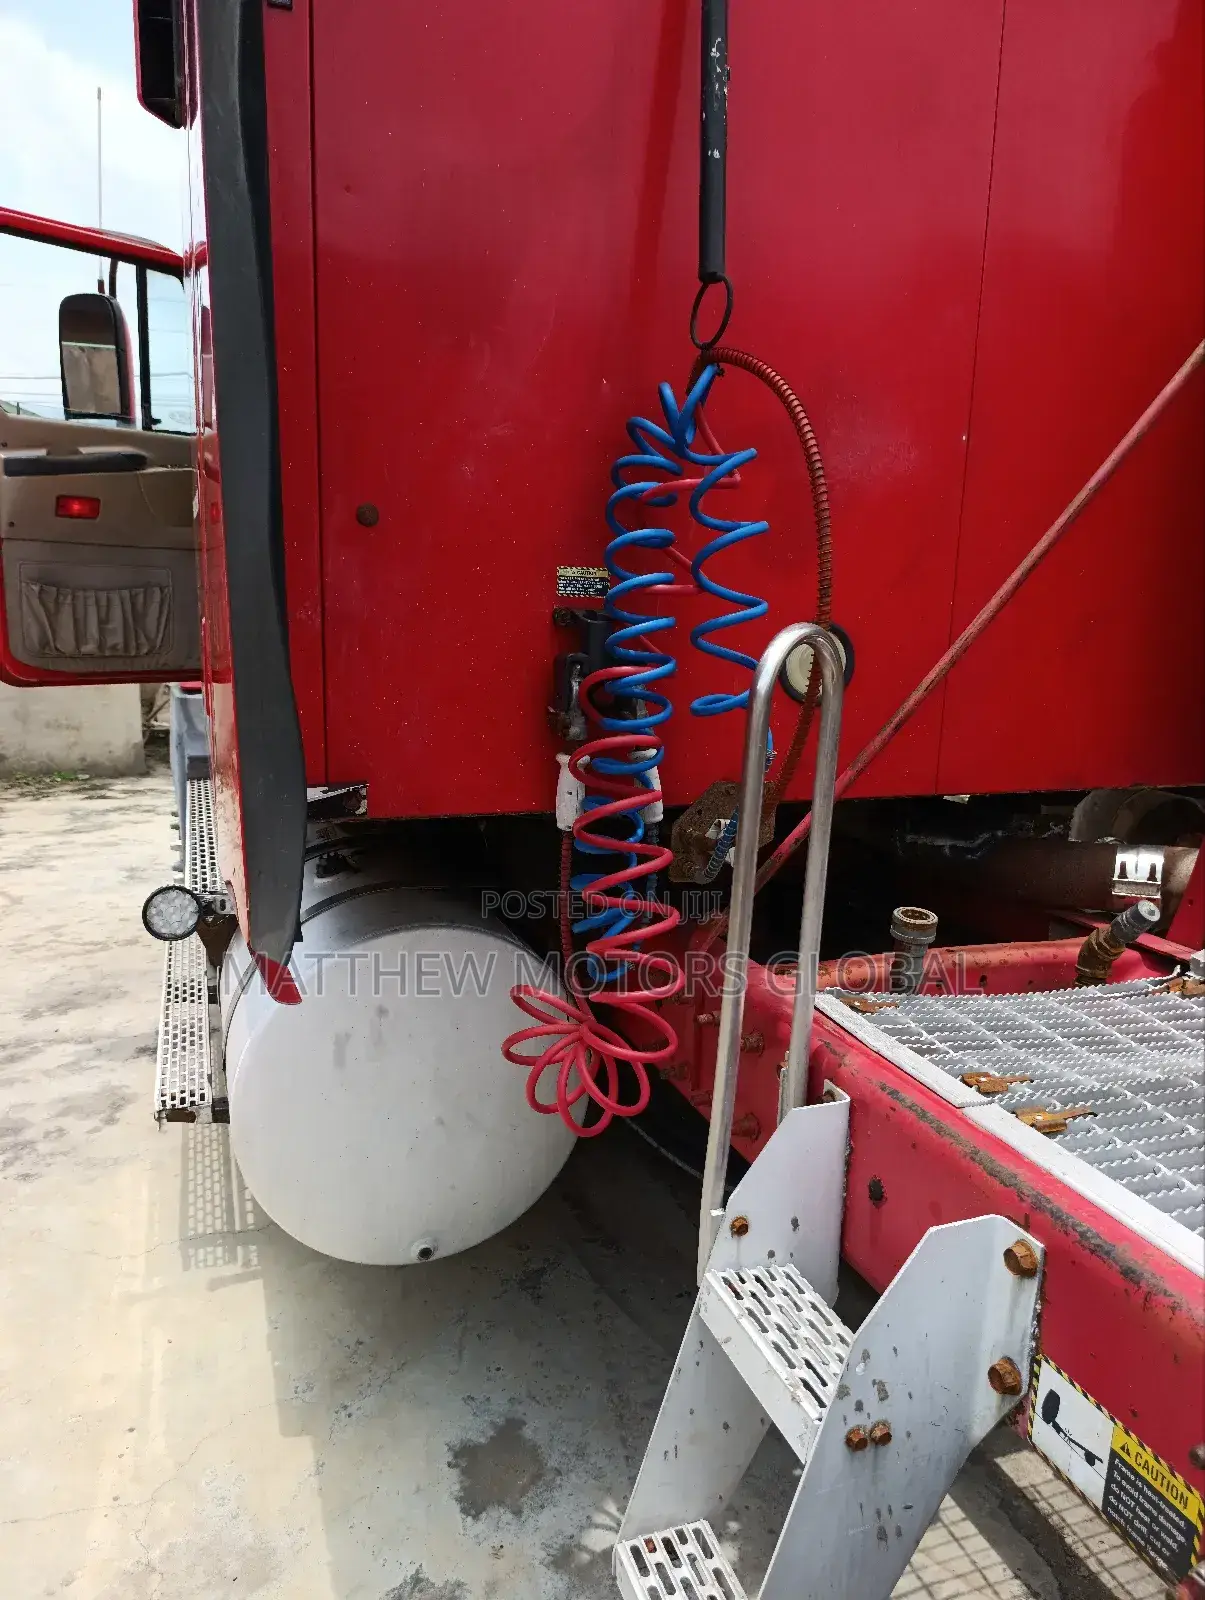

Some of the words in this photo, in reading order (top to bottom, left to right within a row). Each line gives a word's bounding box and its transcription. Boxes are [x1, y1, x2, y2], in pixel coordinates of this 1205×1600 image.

[1113, 1470, 1121, 1482] To
[1121, 1479, 1139, 1499] avoid
[1138, 1495, 1158, 1517] frame
[1114, 1458, 1135, 1481] Frame
[1135, 1477, 1143, 1488] is
[1134, 1451, 1189, 1510] CAUTION
[1108, 1495, 1118, 1506] do
[1118, 1503, 1134, 1520] NOT
[1161, 1547, 1170, 1557] or
[1110, 1483, 1120, 1494] do
[1120, 1491, 1136, 1508] NOT
[1135, 1506, 1151, 1524] heat
[1151, 1522, 1160, 1532] or
[1126, 1524, 1145, 1547] frame
